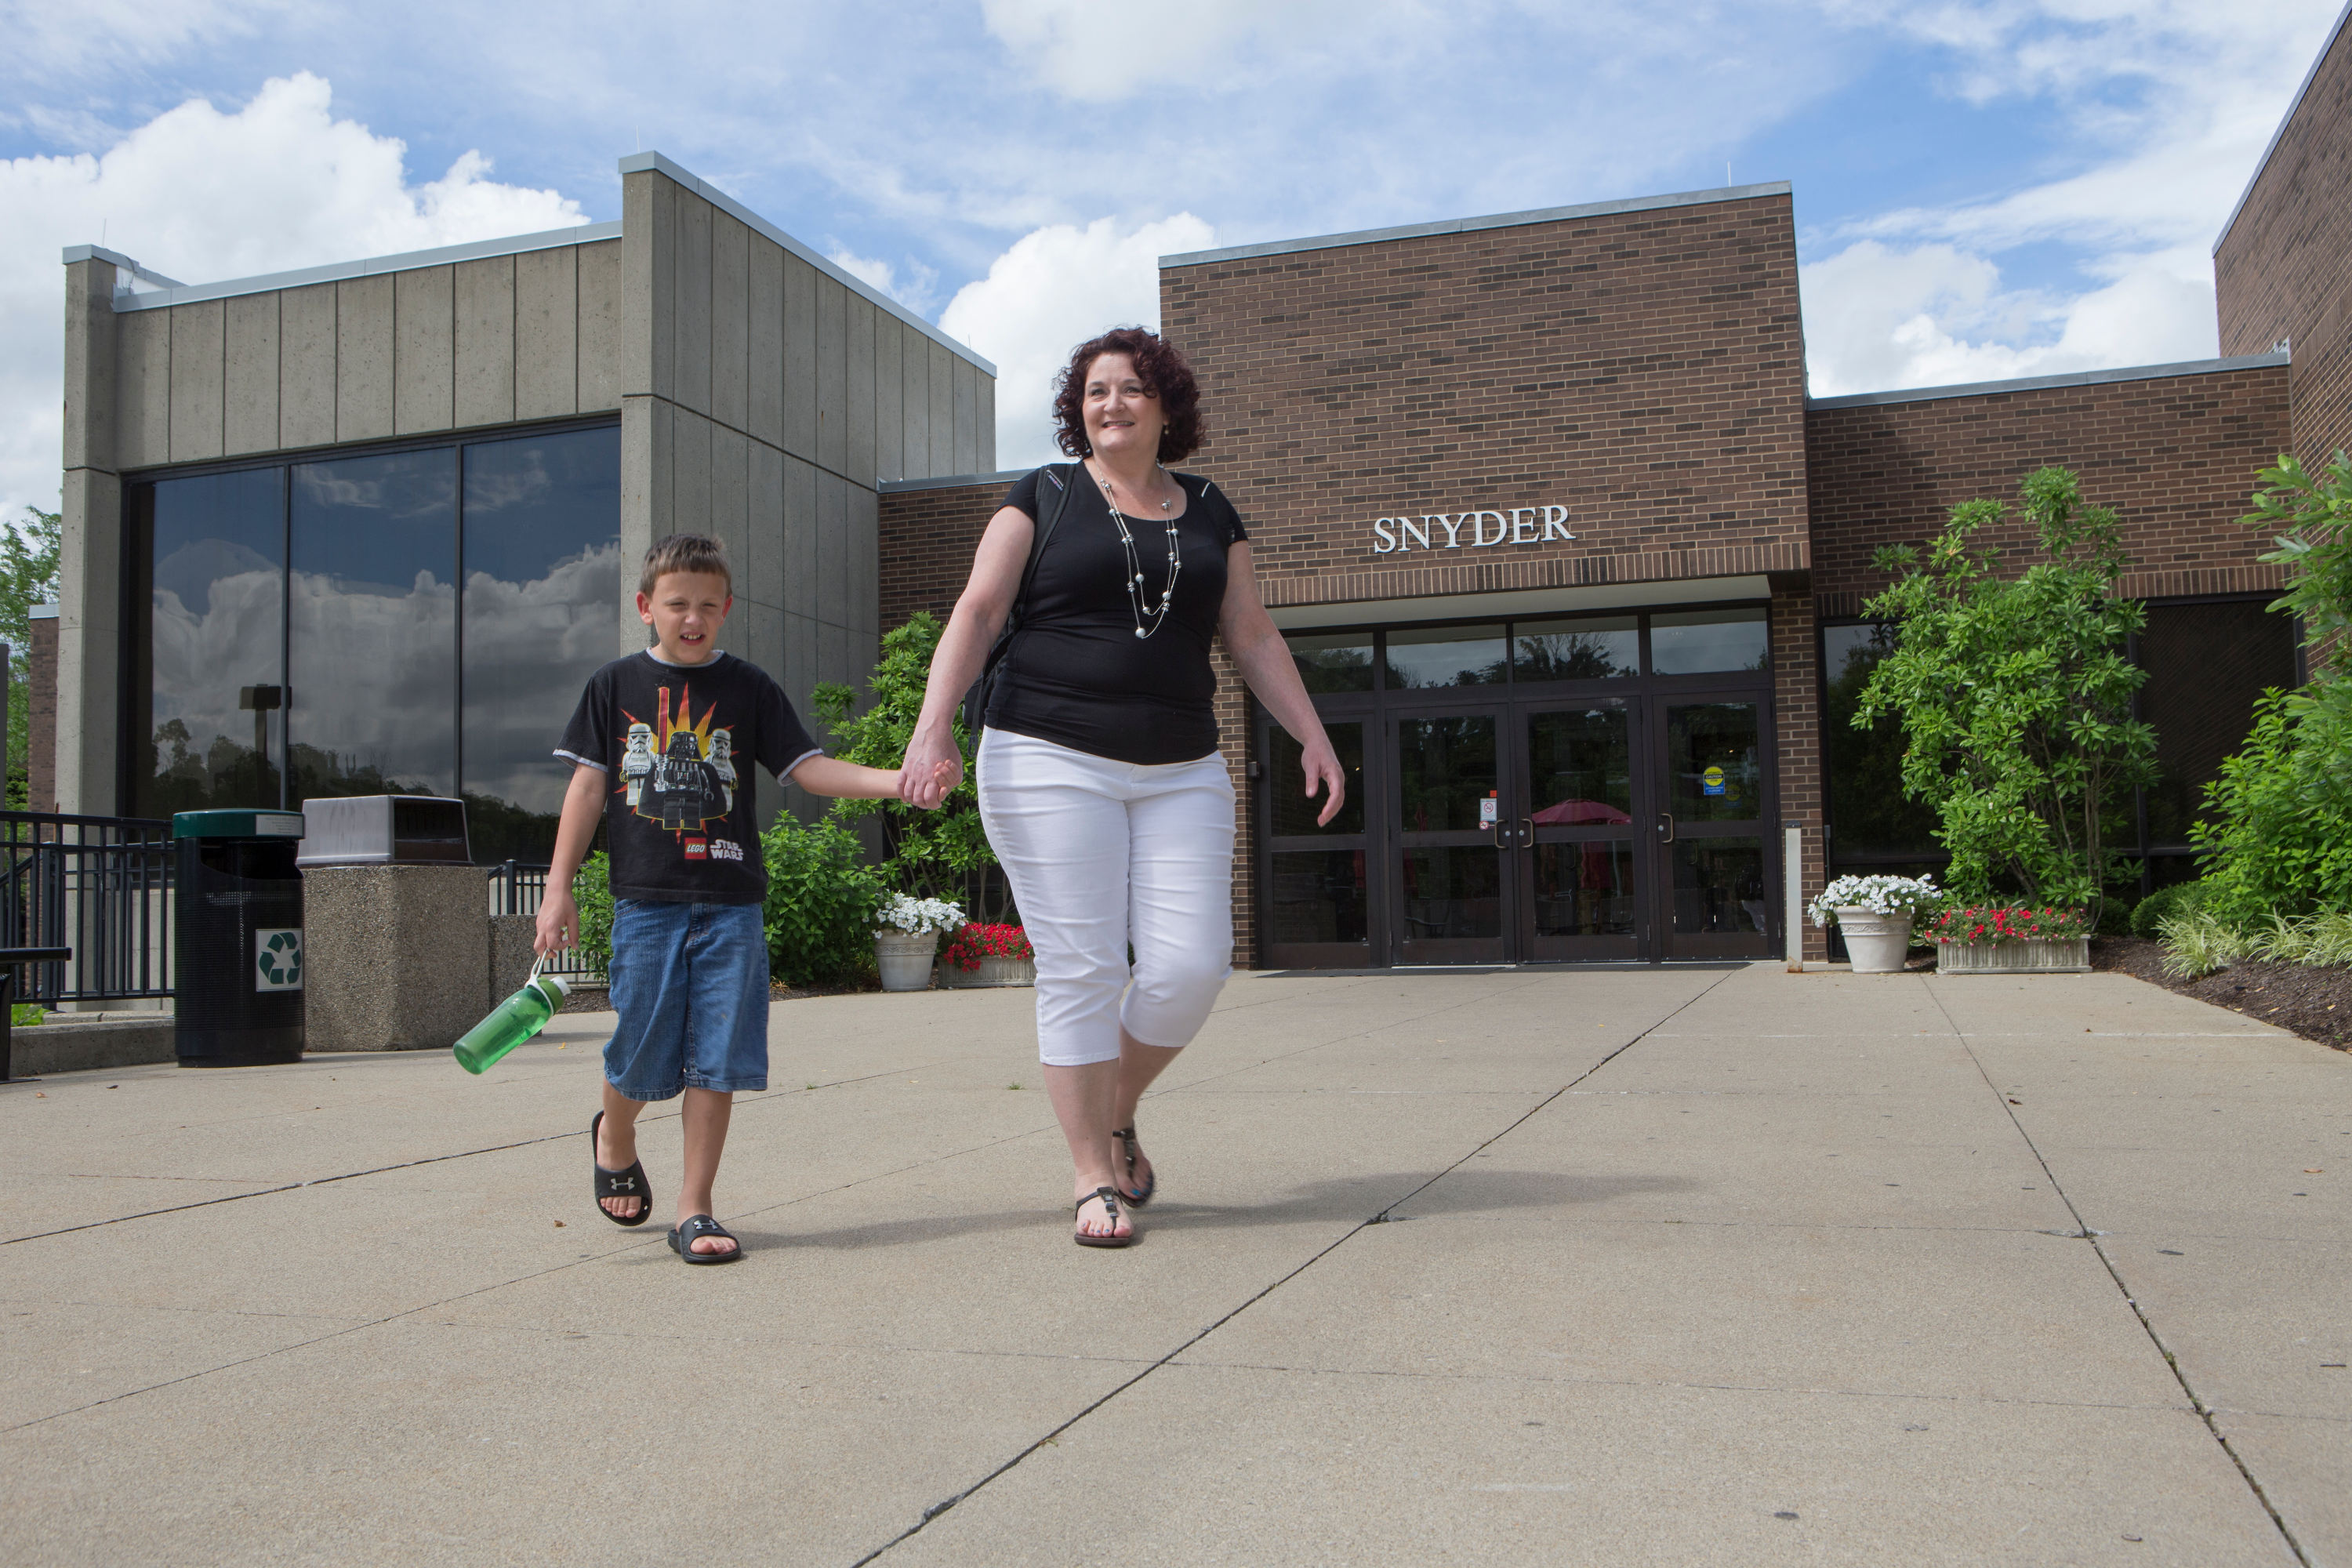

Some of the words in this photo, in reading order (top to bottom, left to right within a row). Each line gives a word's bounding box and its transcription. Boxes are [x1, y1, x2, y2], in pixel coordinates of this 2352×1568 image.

[1374, 505, 1577, 554] SNYDER
[687, 844, 706, 854] LEGO
[710, 839, 743, 852] STAR
[710, 848, 744, 862] WARS
